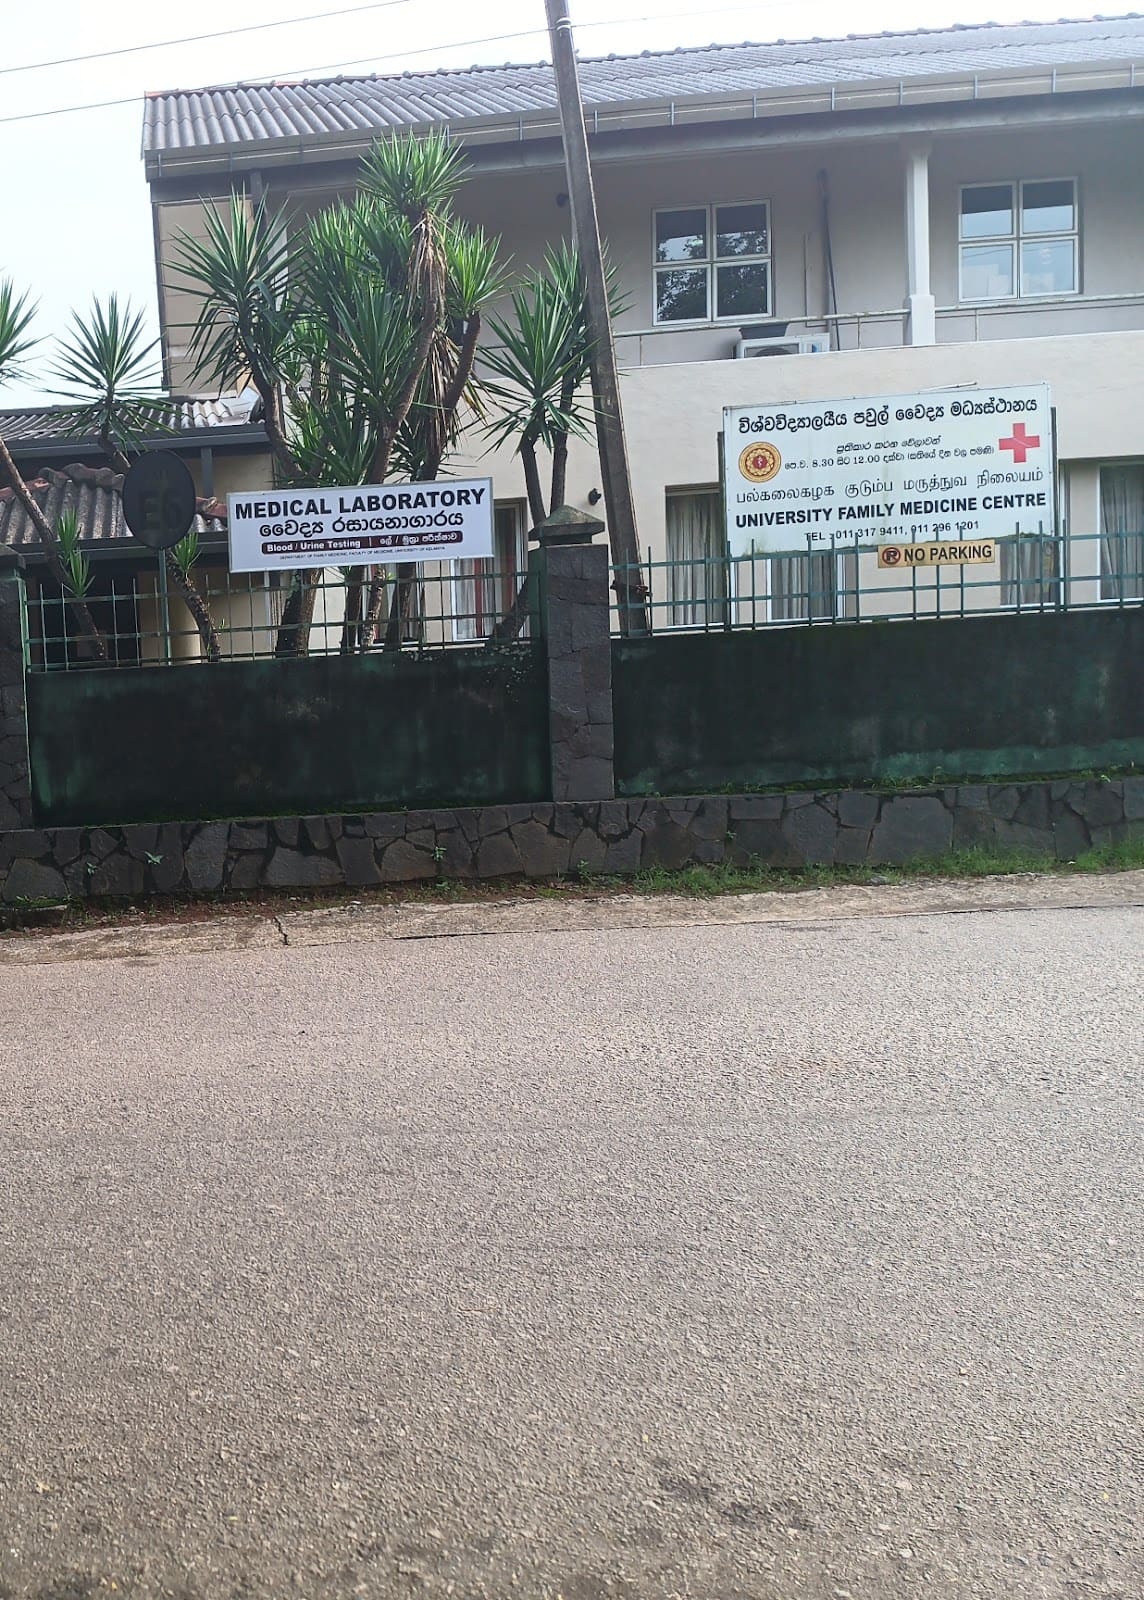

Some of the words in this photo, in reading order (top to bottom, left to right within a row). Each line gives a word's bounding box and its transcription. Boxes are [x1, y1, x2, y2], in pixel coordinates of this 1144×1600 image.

[854, 405, 889, 427] පවුල්
[812, 458, 834, 468] 8.30
[836, 456, 850, 466] සිට
[853, 454, 880, 465] 12.00
[736, 485, 835, 504] பல்கலைகழக
[844, 478, 893, 498] குடும்ப
[976, 467, 1044, 488] நிலையம்
[236, 498, 332, 520] MEDICAL
[339, 488, 486, 514] LABORATORY
[736, 508, 833, 528] UNIVERSITY
[838, 503, 895, 520] FAMILY
[900, 497, 977, 516] MEDICINE
[982, 492, 1046, 510] CENTRE
[332, 510, 464, 533] රසායනාගාරය
[804, 532, 826, 542] TEL
[836, 530, 853, 540] 011
[858, 528, 876, 538] 317
[880, 526, 908, 536] 9411,
[932, 522, 951, 532] 296
[955, 520, 980, 531] 1201
[266, 543, 293, 552] Blood
[300, 542, 324, 550] Urine
[328, 539, 361, 549] Testing
[904, 548, 925, 562] NO
[930, 544, 992, 560] PARKING
